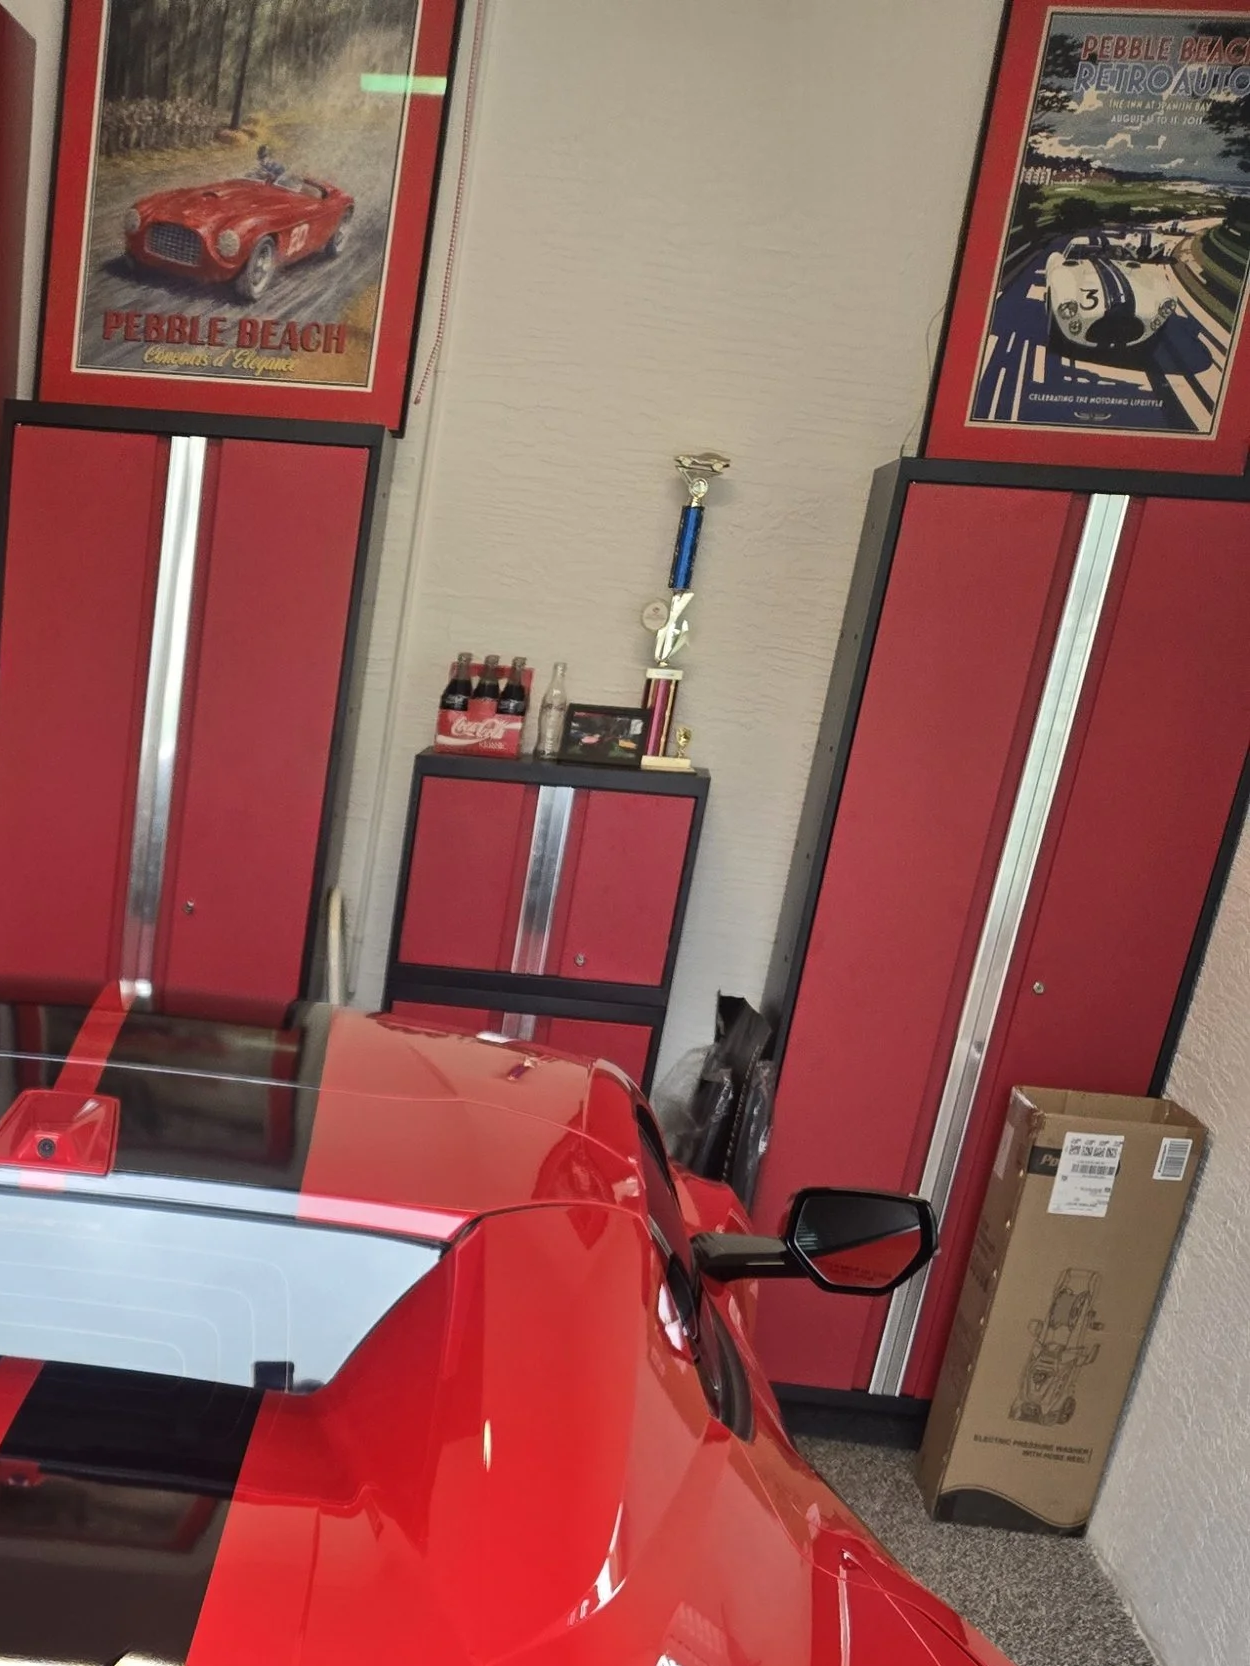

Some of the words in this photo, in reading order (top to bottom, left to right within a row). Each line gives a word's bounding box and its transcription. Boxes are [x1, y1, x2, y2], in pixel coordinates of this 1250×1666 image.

[1080, 34, 1175, 62] PEBBLE
[1073, 61, 1250, 97] RETROAUTO
[1194, 101, 1213, 111] BAY
[1079, 287, 1099, 310] 3
[103, 309, 227, 347] PEBBLE
[236, 316, 347, 354] BEACH
[1029, 393, 1073, 403] CELEBRATING
[1076, 396, 1088, 404] THE
[1089, 397, 1128, 406] MOTORING
[1130, 398, 1164, 408] LIFESTYLE
